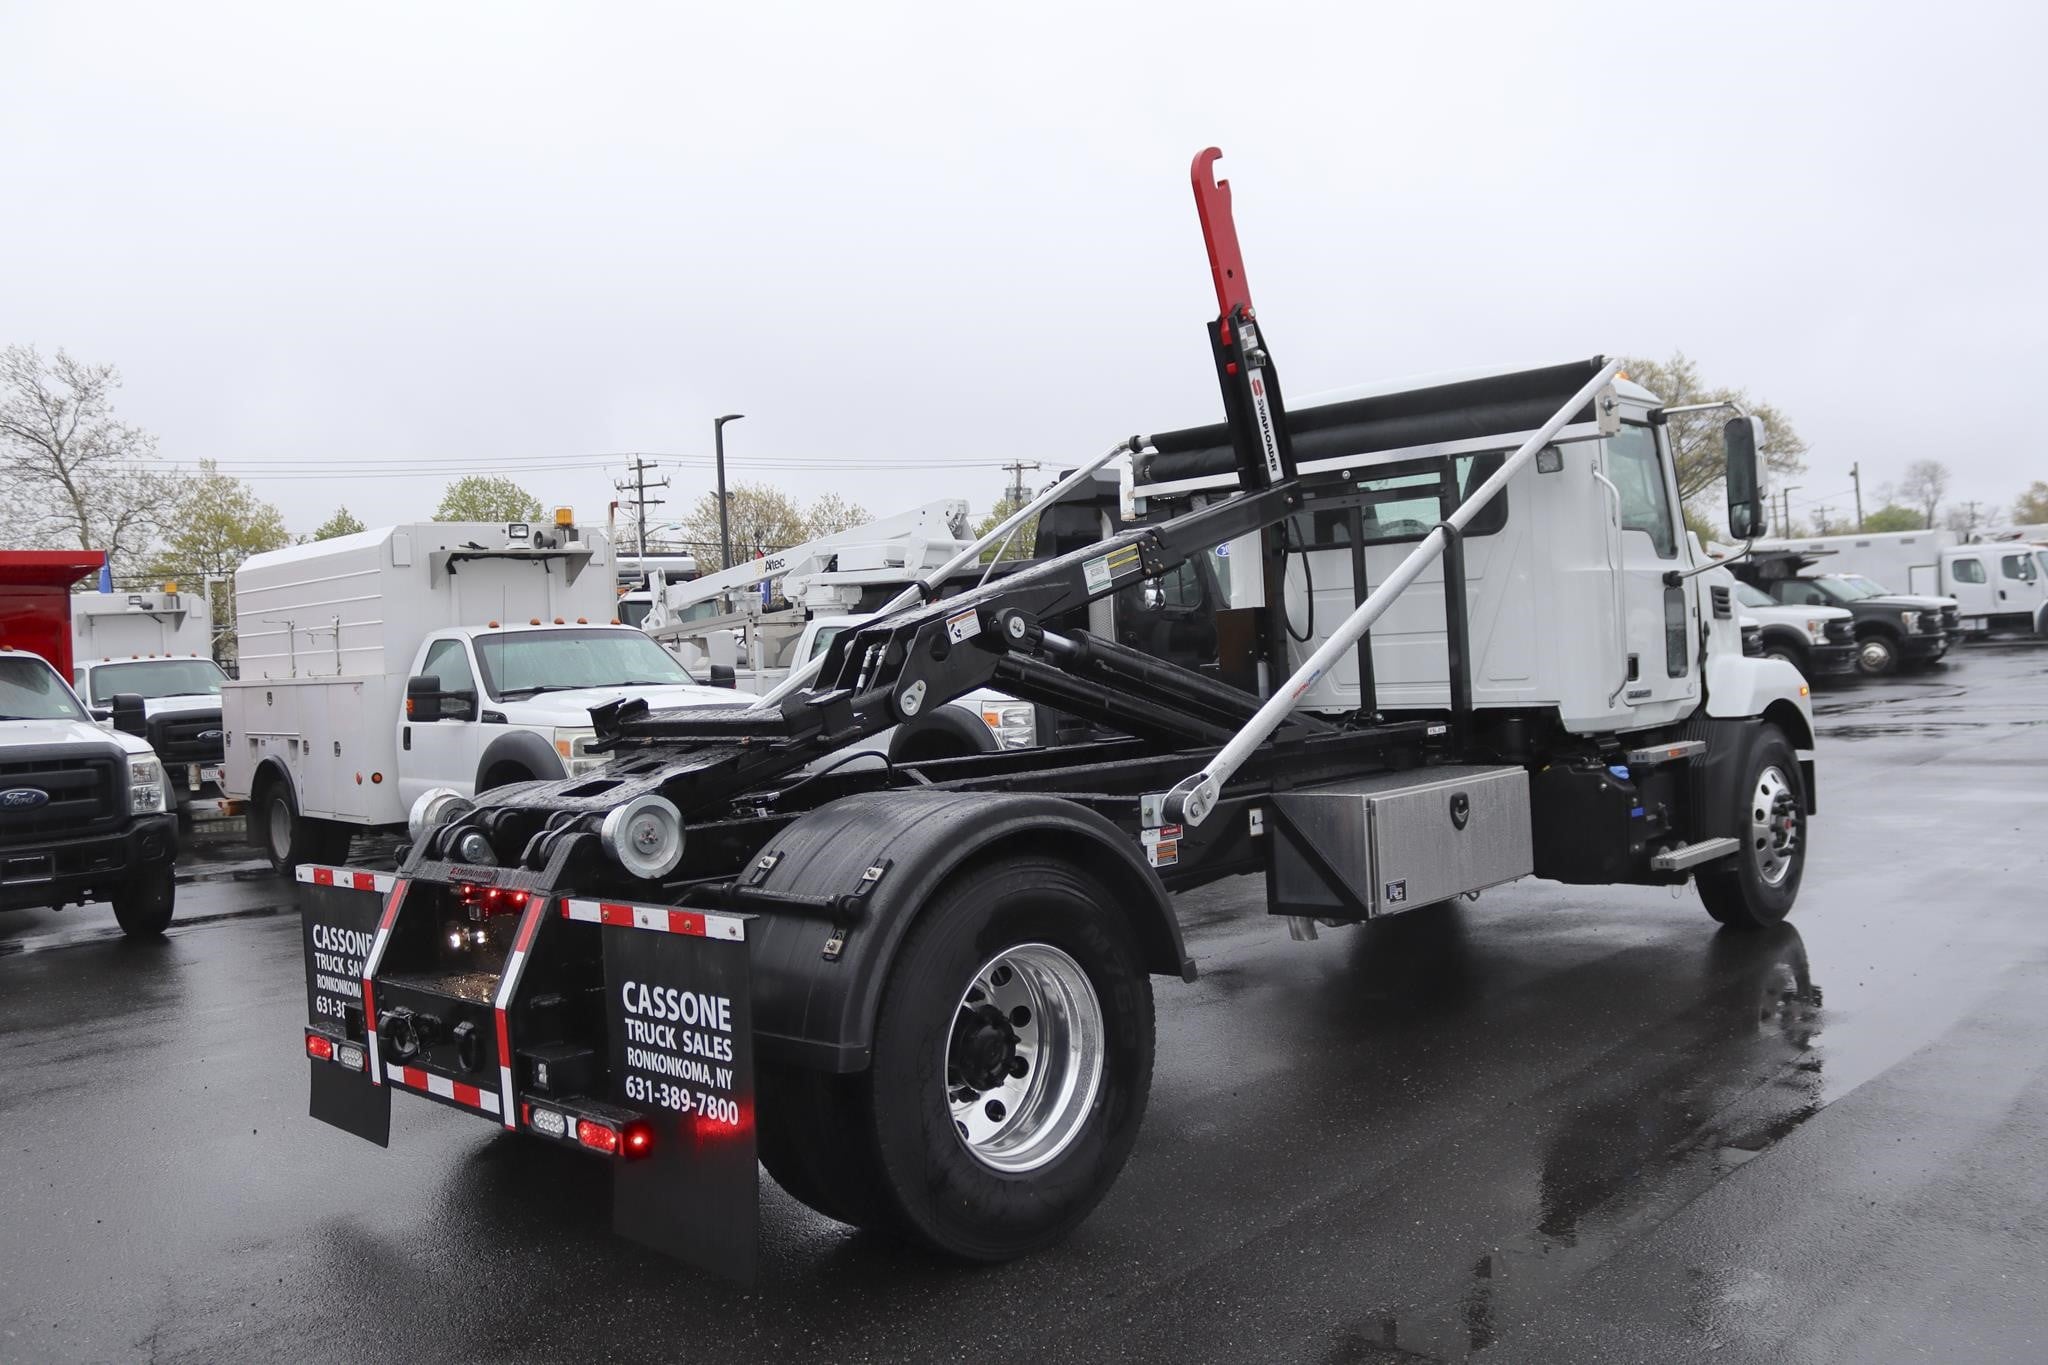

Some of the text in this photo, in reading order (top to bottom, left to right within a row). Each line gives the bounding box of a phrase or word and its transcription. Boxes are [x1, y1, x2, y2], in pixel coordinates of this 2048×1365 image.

[1257, 398, 1278, 472] SWAPLOADER
[765, 558, 785, 573] Altec
[3, 791, 36, 807] Ford
[314, 952, 345, 974] TRUCK
[623, 981, 732, 1032] CASSONE
[624, 1017, 733, 1063] TRUCK SALES
[627, 1047, 733, 1090] RONKONKOMA, NY
[625, 1075, 738, 1125] 631-389-7800
